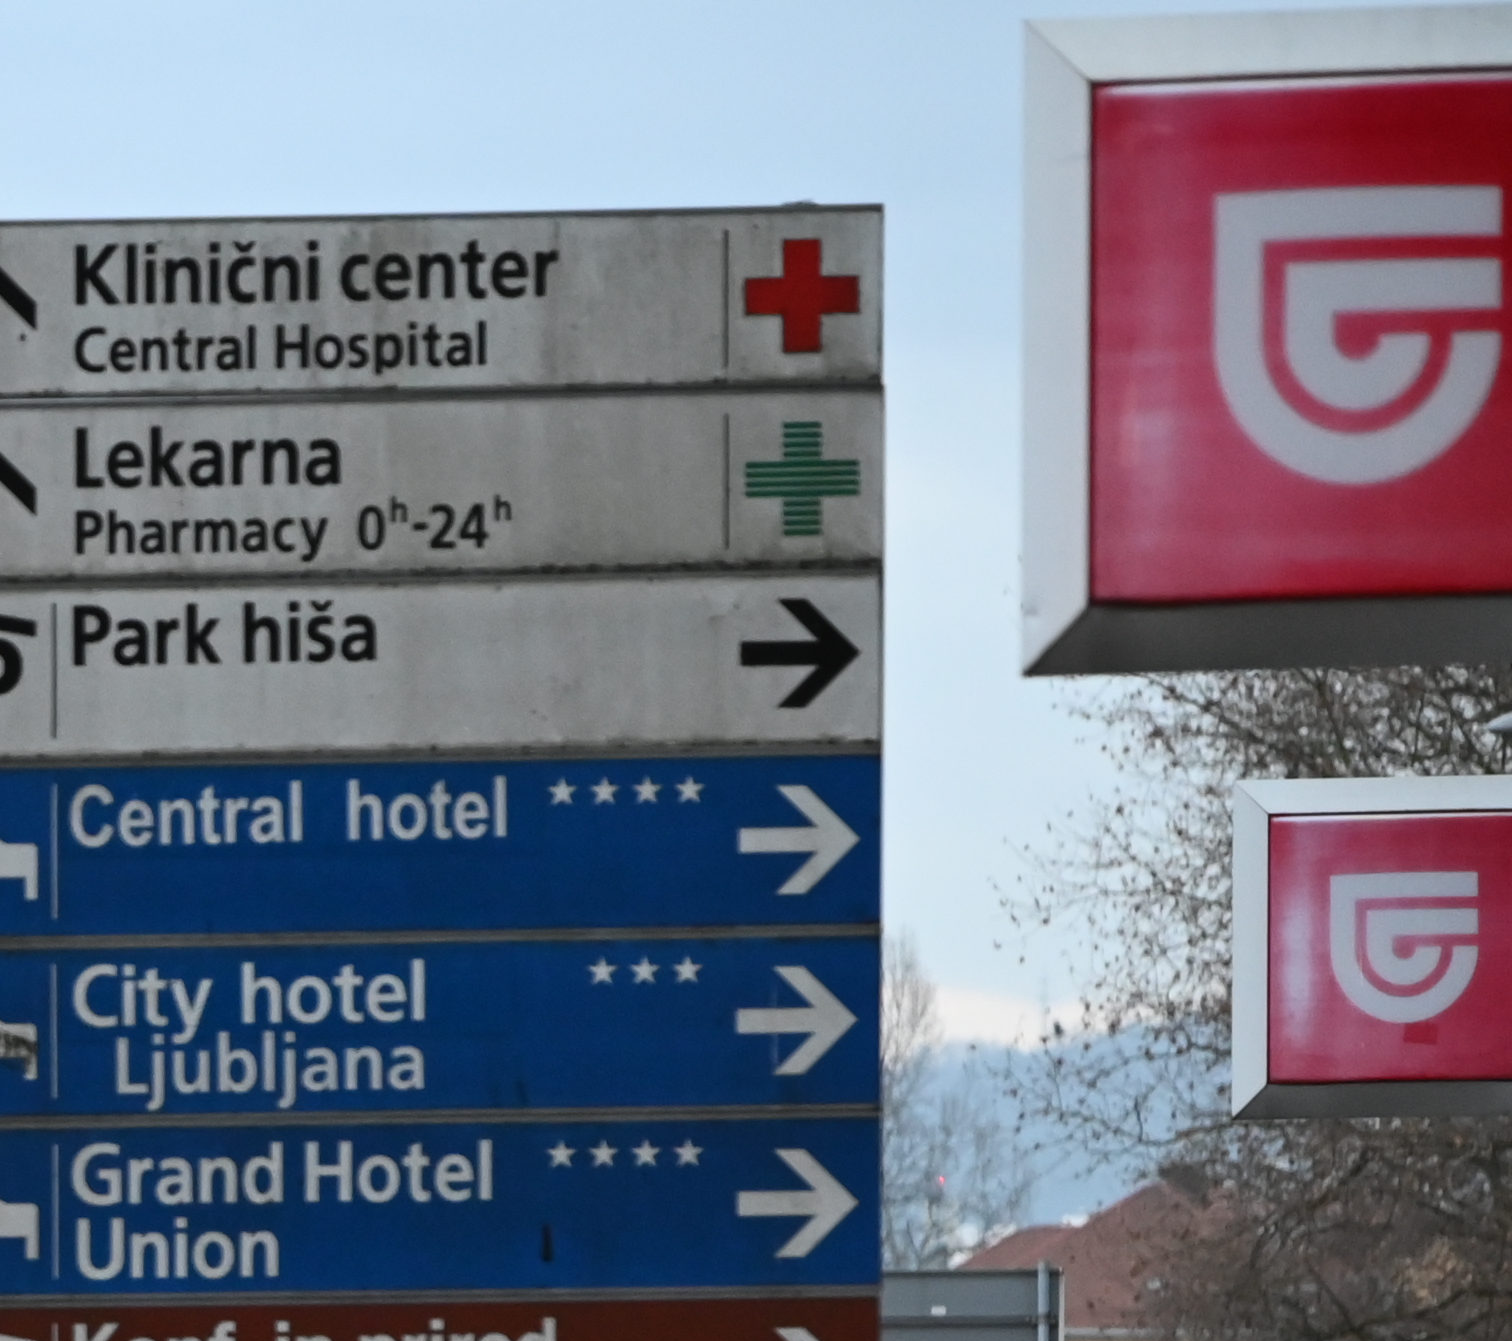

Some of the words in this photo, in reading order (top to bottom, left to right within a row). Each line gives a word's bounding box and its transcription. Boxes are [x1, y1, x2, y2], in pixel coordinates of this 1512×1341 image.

[75, 239, 319, 305] Klinični
[340, 238, 560, 300] center
[74, 322, 256, 374] Central
[275, 319, 487, 376] Hospital
[75, 425, 341, 489] Lekarna
[75, 509, 328, 562] Pharmacy
[72, 603, 221, 667] Park
[243, 600, 377, 664] hiša
[70, 780, 303, 848] Central
[347, 775, 508, 841] hotel
[73, 962, 213, 1043] City
[241, 958, 426, 1024] hotel
[116, 1030, 425, 1111] Ljubljana
[71, 1141, 284, 1206] Grand
[305, 1139, 493, 1203] Hotel
[76, 1216, 279, 1281] Union
